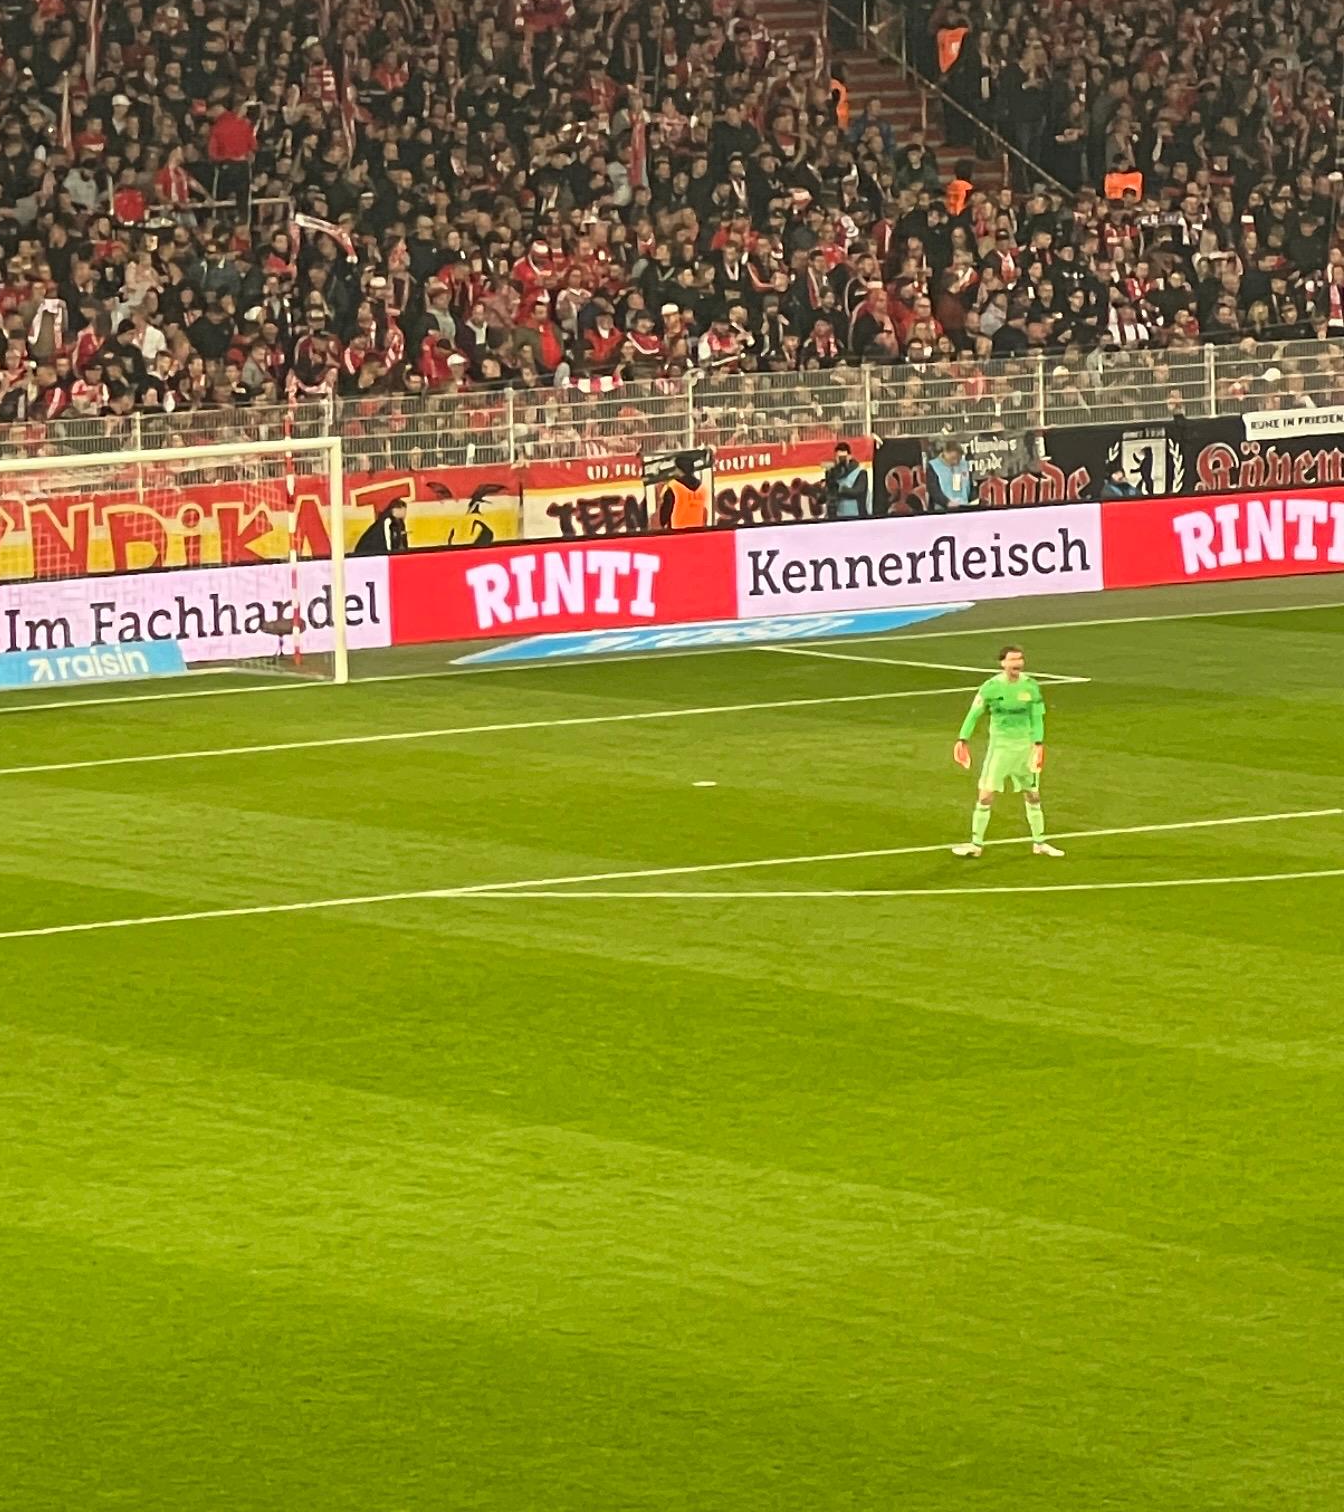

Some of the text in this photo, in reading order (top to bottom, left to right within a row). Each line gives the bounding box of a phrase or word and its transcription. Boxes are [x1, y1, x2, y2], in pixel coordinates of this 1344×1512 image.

[465, 548, 660, 630] RINTI
[747, 527, 1091, 598] Kennerfleisch
[3, 609, 70, 653] Im
[56, 641, 150, 679] raisin
